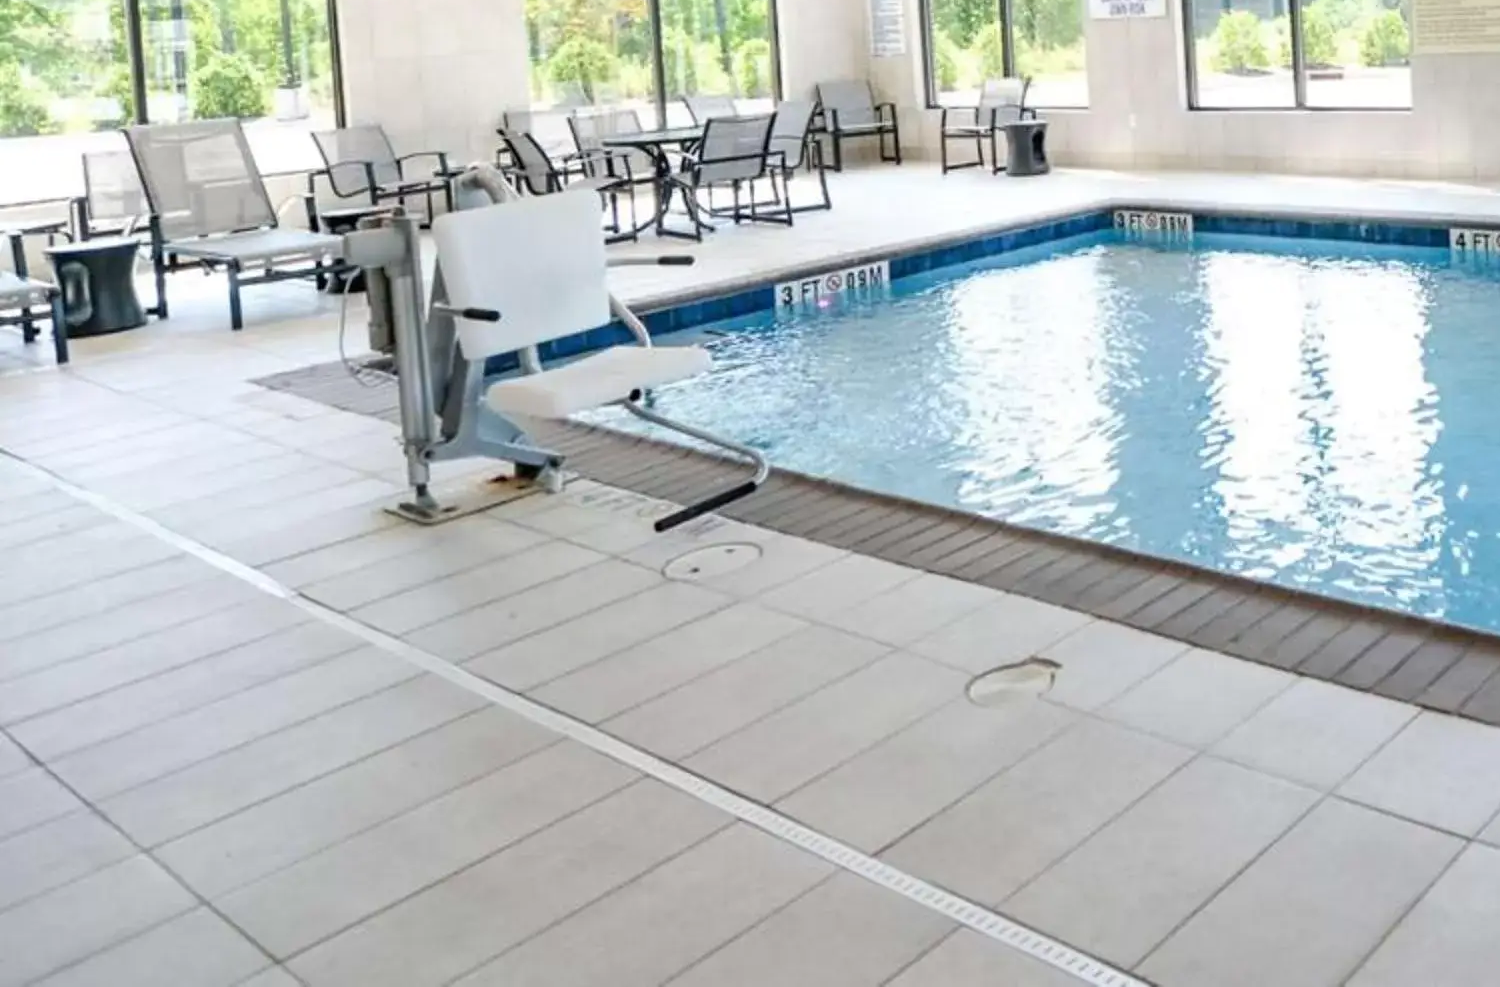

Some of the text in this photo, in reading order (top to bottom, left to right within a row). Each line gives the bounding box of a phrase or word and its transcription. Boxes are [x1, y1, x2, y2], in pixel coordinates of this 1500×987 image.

[1455, 232, 1466, 251] 4
[1473, 233, 1490, 252] FT
[780, 285, 794, 305] 3
[801, 278, 821, 303] FT
